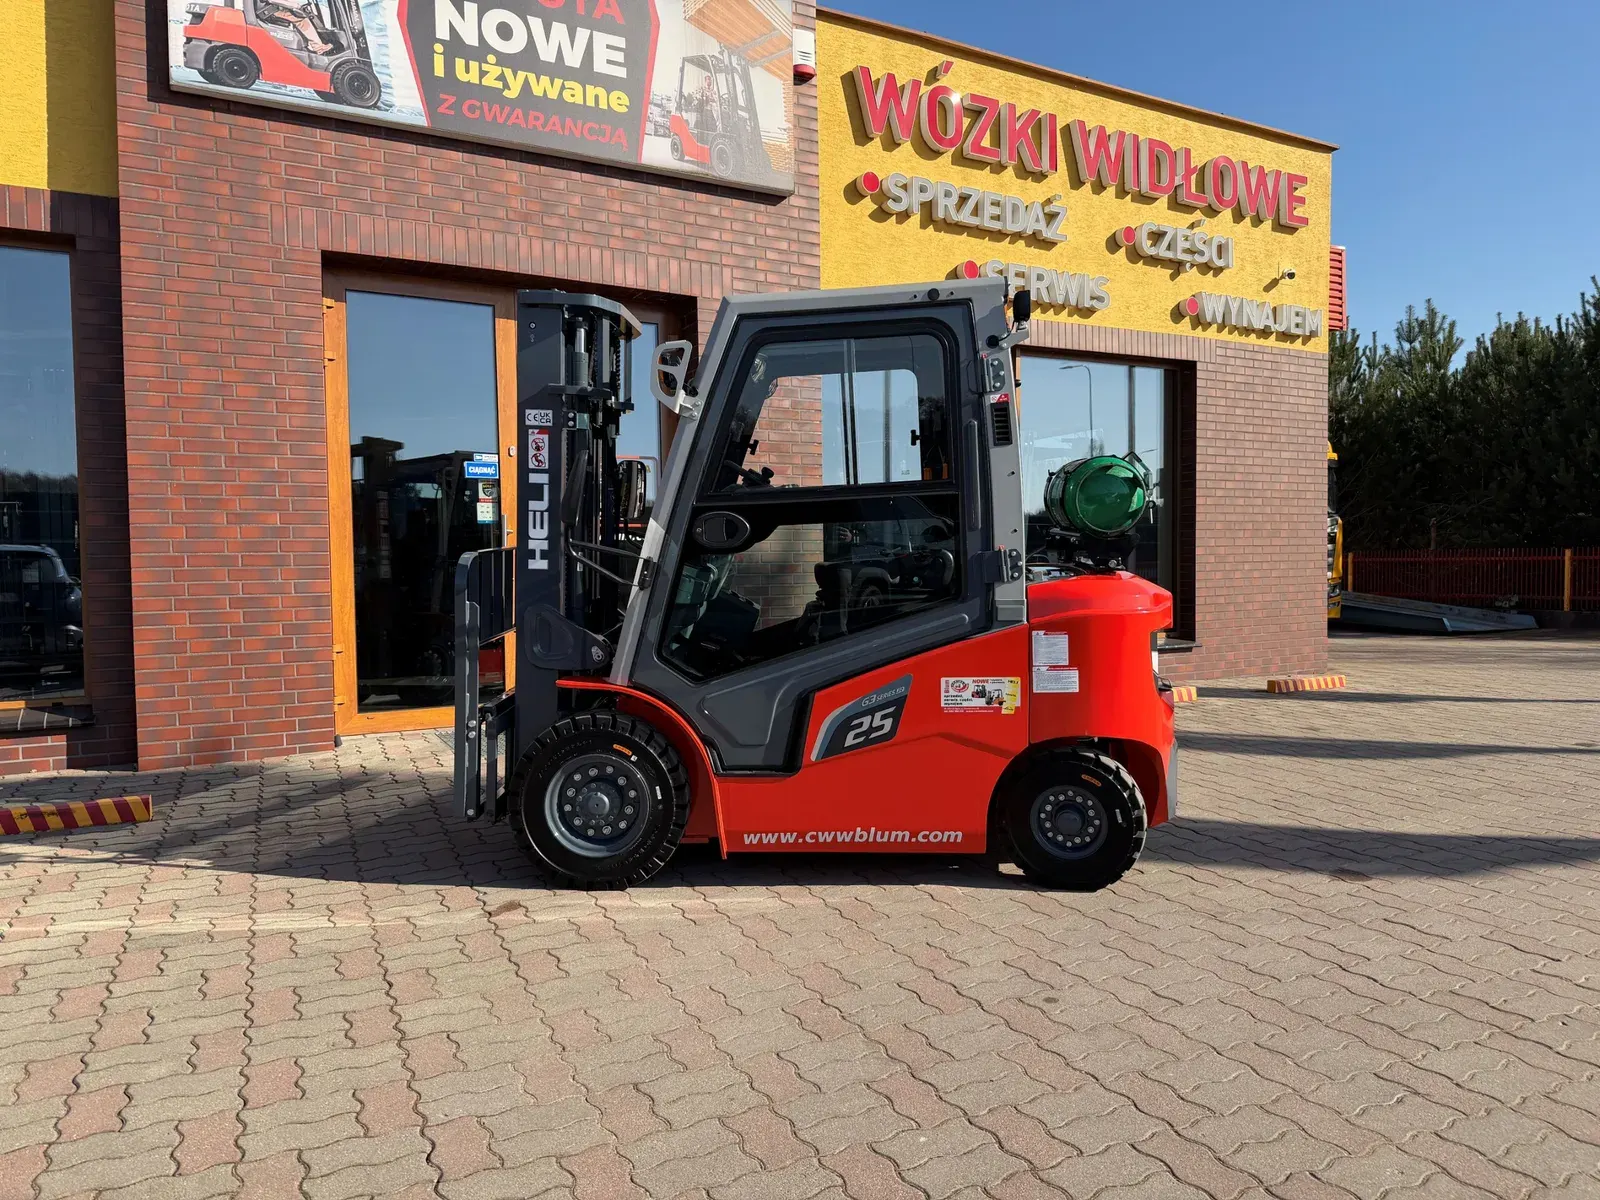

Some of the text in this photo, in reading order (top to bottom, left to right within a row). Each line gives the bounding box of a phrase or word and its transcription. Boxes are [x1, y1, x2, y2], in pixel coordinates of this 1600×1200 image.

[435, 0, 627, 78] NOWE
[433, 43, 630, 113] i używane
[437, 94, 629, 152] Z GWARANCJĄ
[856, 60, 1309, 227] WÓZKI WIDŁOWE
[884, 172, 1067, 242] SPRZEDAŻ
[1140, 218, 1234, 273] CZĘŚCI
[1201, 292, 1323, 337] WYNAJEM
[527, 473, 549, 570] HELI
[844, 706, 896, 748] 25
[861, 694, 877, 707] G3
[743, 827, 963, 844] www.cwwblum.com
